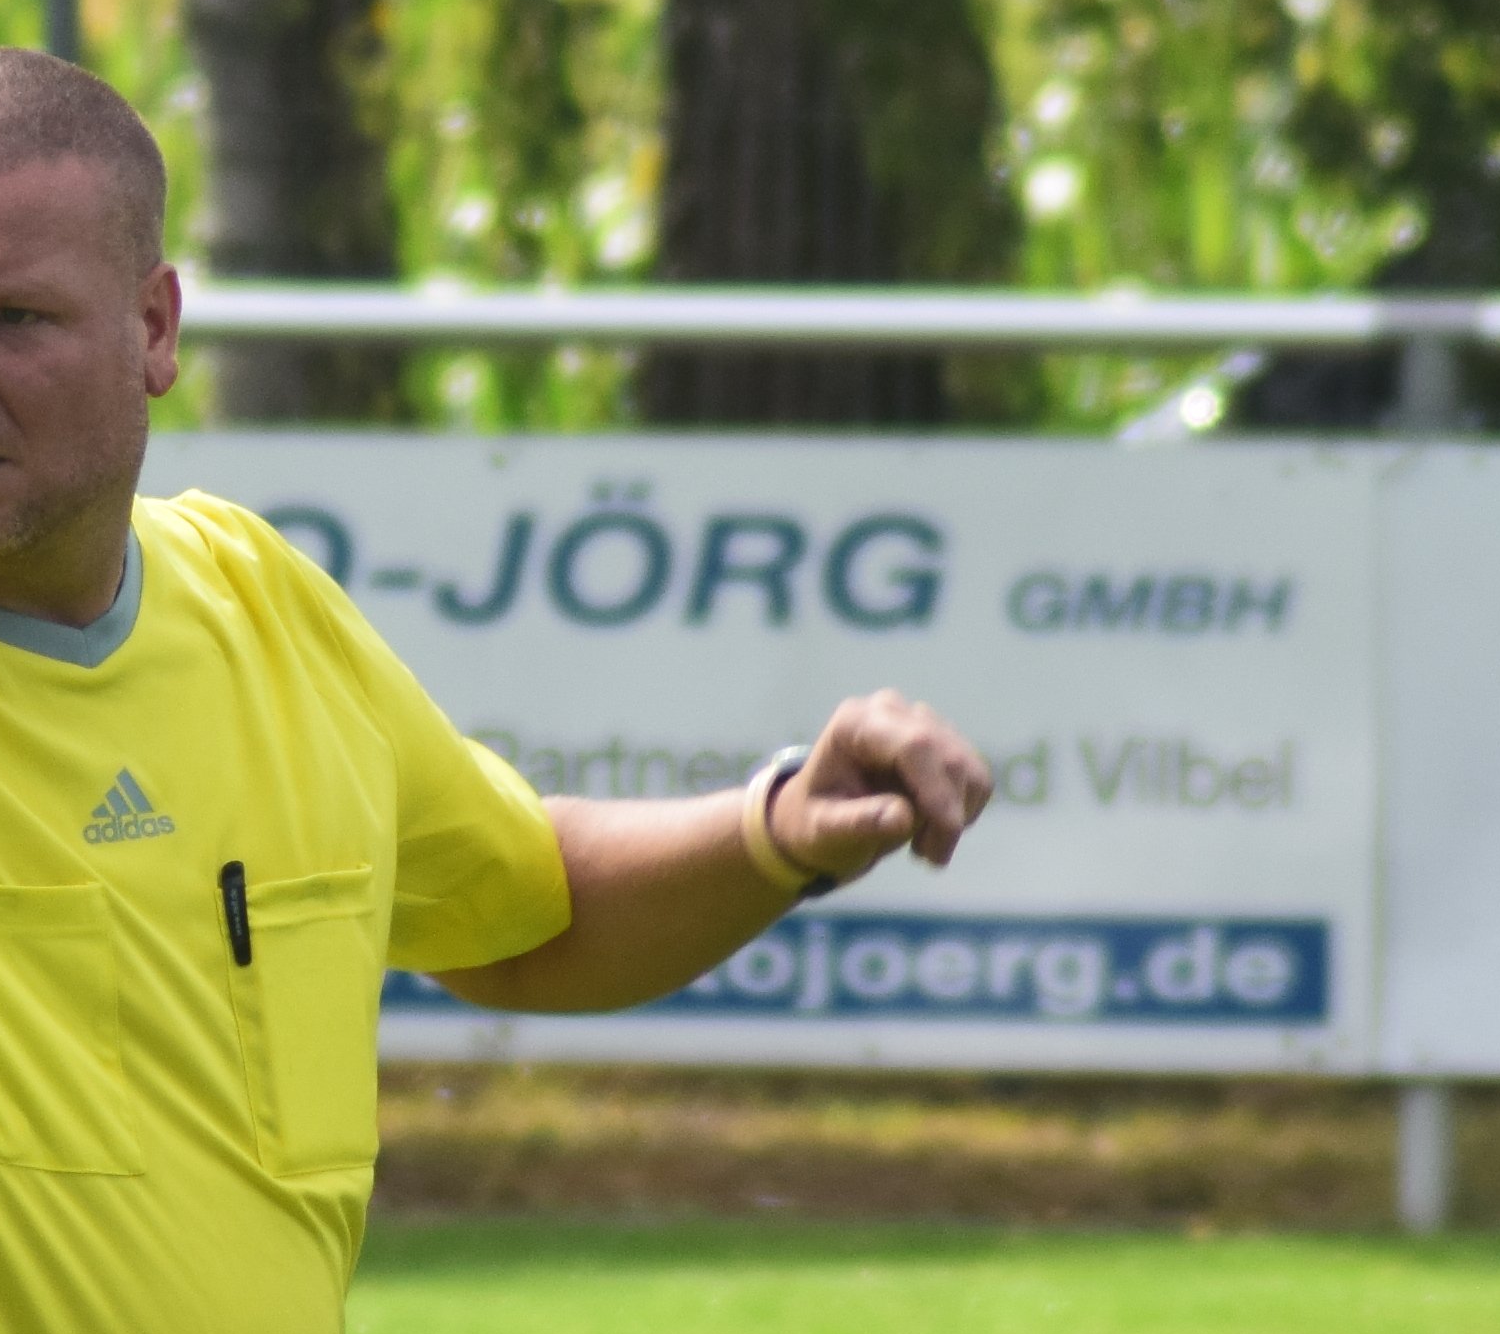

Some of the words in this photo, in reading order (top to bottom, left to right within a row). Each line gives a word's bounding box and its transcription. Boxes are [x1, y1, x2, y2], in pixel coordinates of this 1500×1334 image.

[1006, 571, 1295, 635] GMBH
[1076, 733, 1296, 810] Vilbel
[83, 811, 176, 845] adidas
[693, 921, 1296, 1017] ojoerg.de
